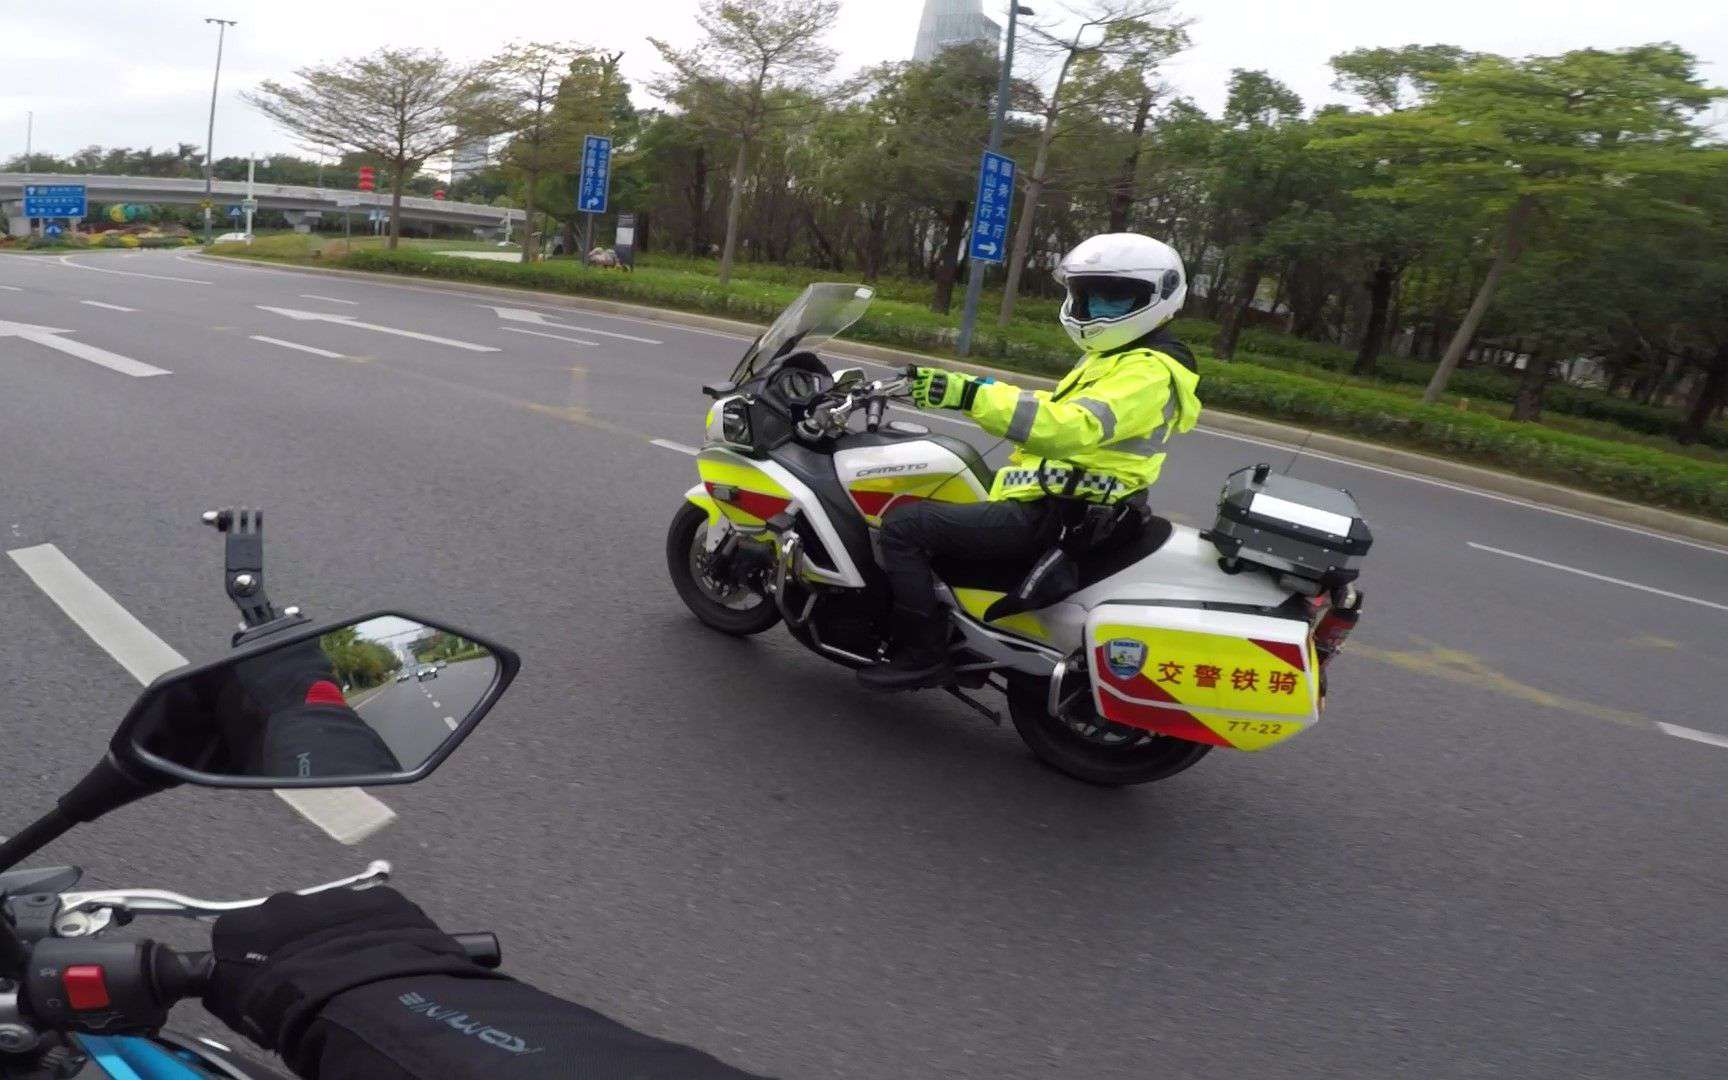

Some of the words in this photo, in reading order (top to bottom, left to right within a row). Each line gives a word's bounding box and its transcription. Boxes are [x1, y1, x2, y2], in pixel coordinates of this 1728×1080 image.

[1157, 661, 1297, 695] 交警铁骑
[1227, 720, 1282, 735] 77-22
